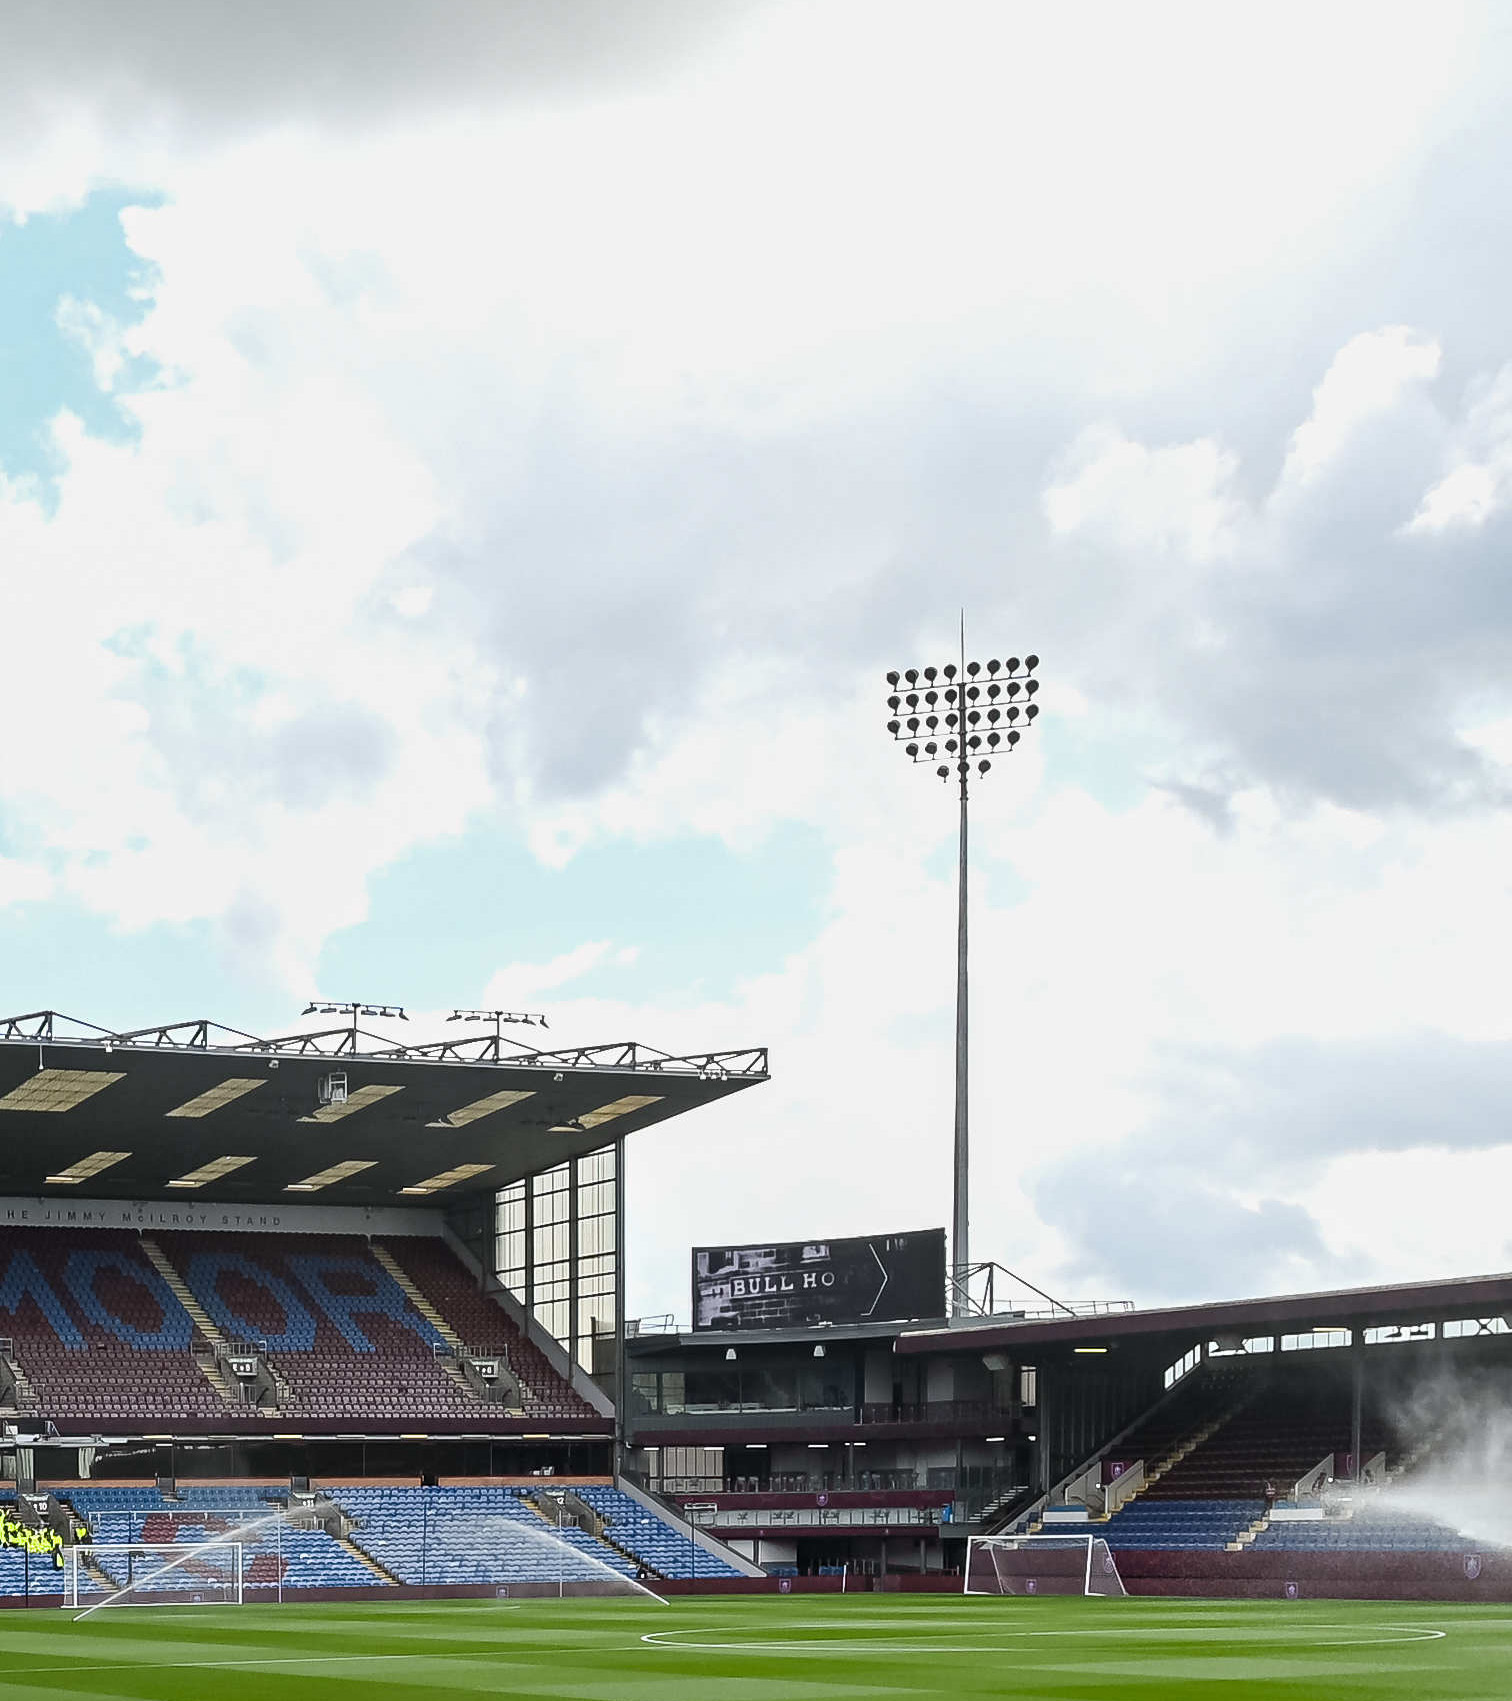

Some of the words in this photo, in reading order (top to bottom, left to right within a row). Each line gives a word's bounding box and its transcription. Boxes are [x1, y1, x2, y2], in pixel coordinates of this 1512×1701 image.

[45, 1210, 106, 1222] JIMMY
[222, 1214, 281, 1226] STAND
[733, 1276, 794, 1296] BULL
